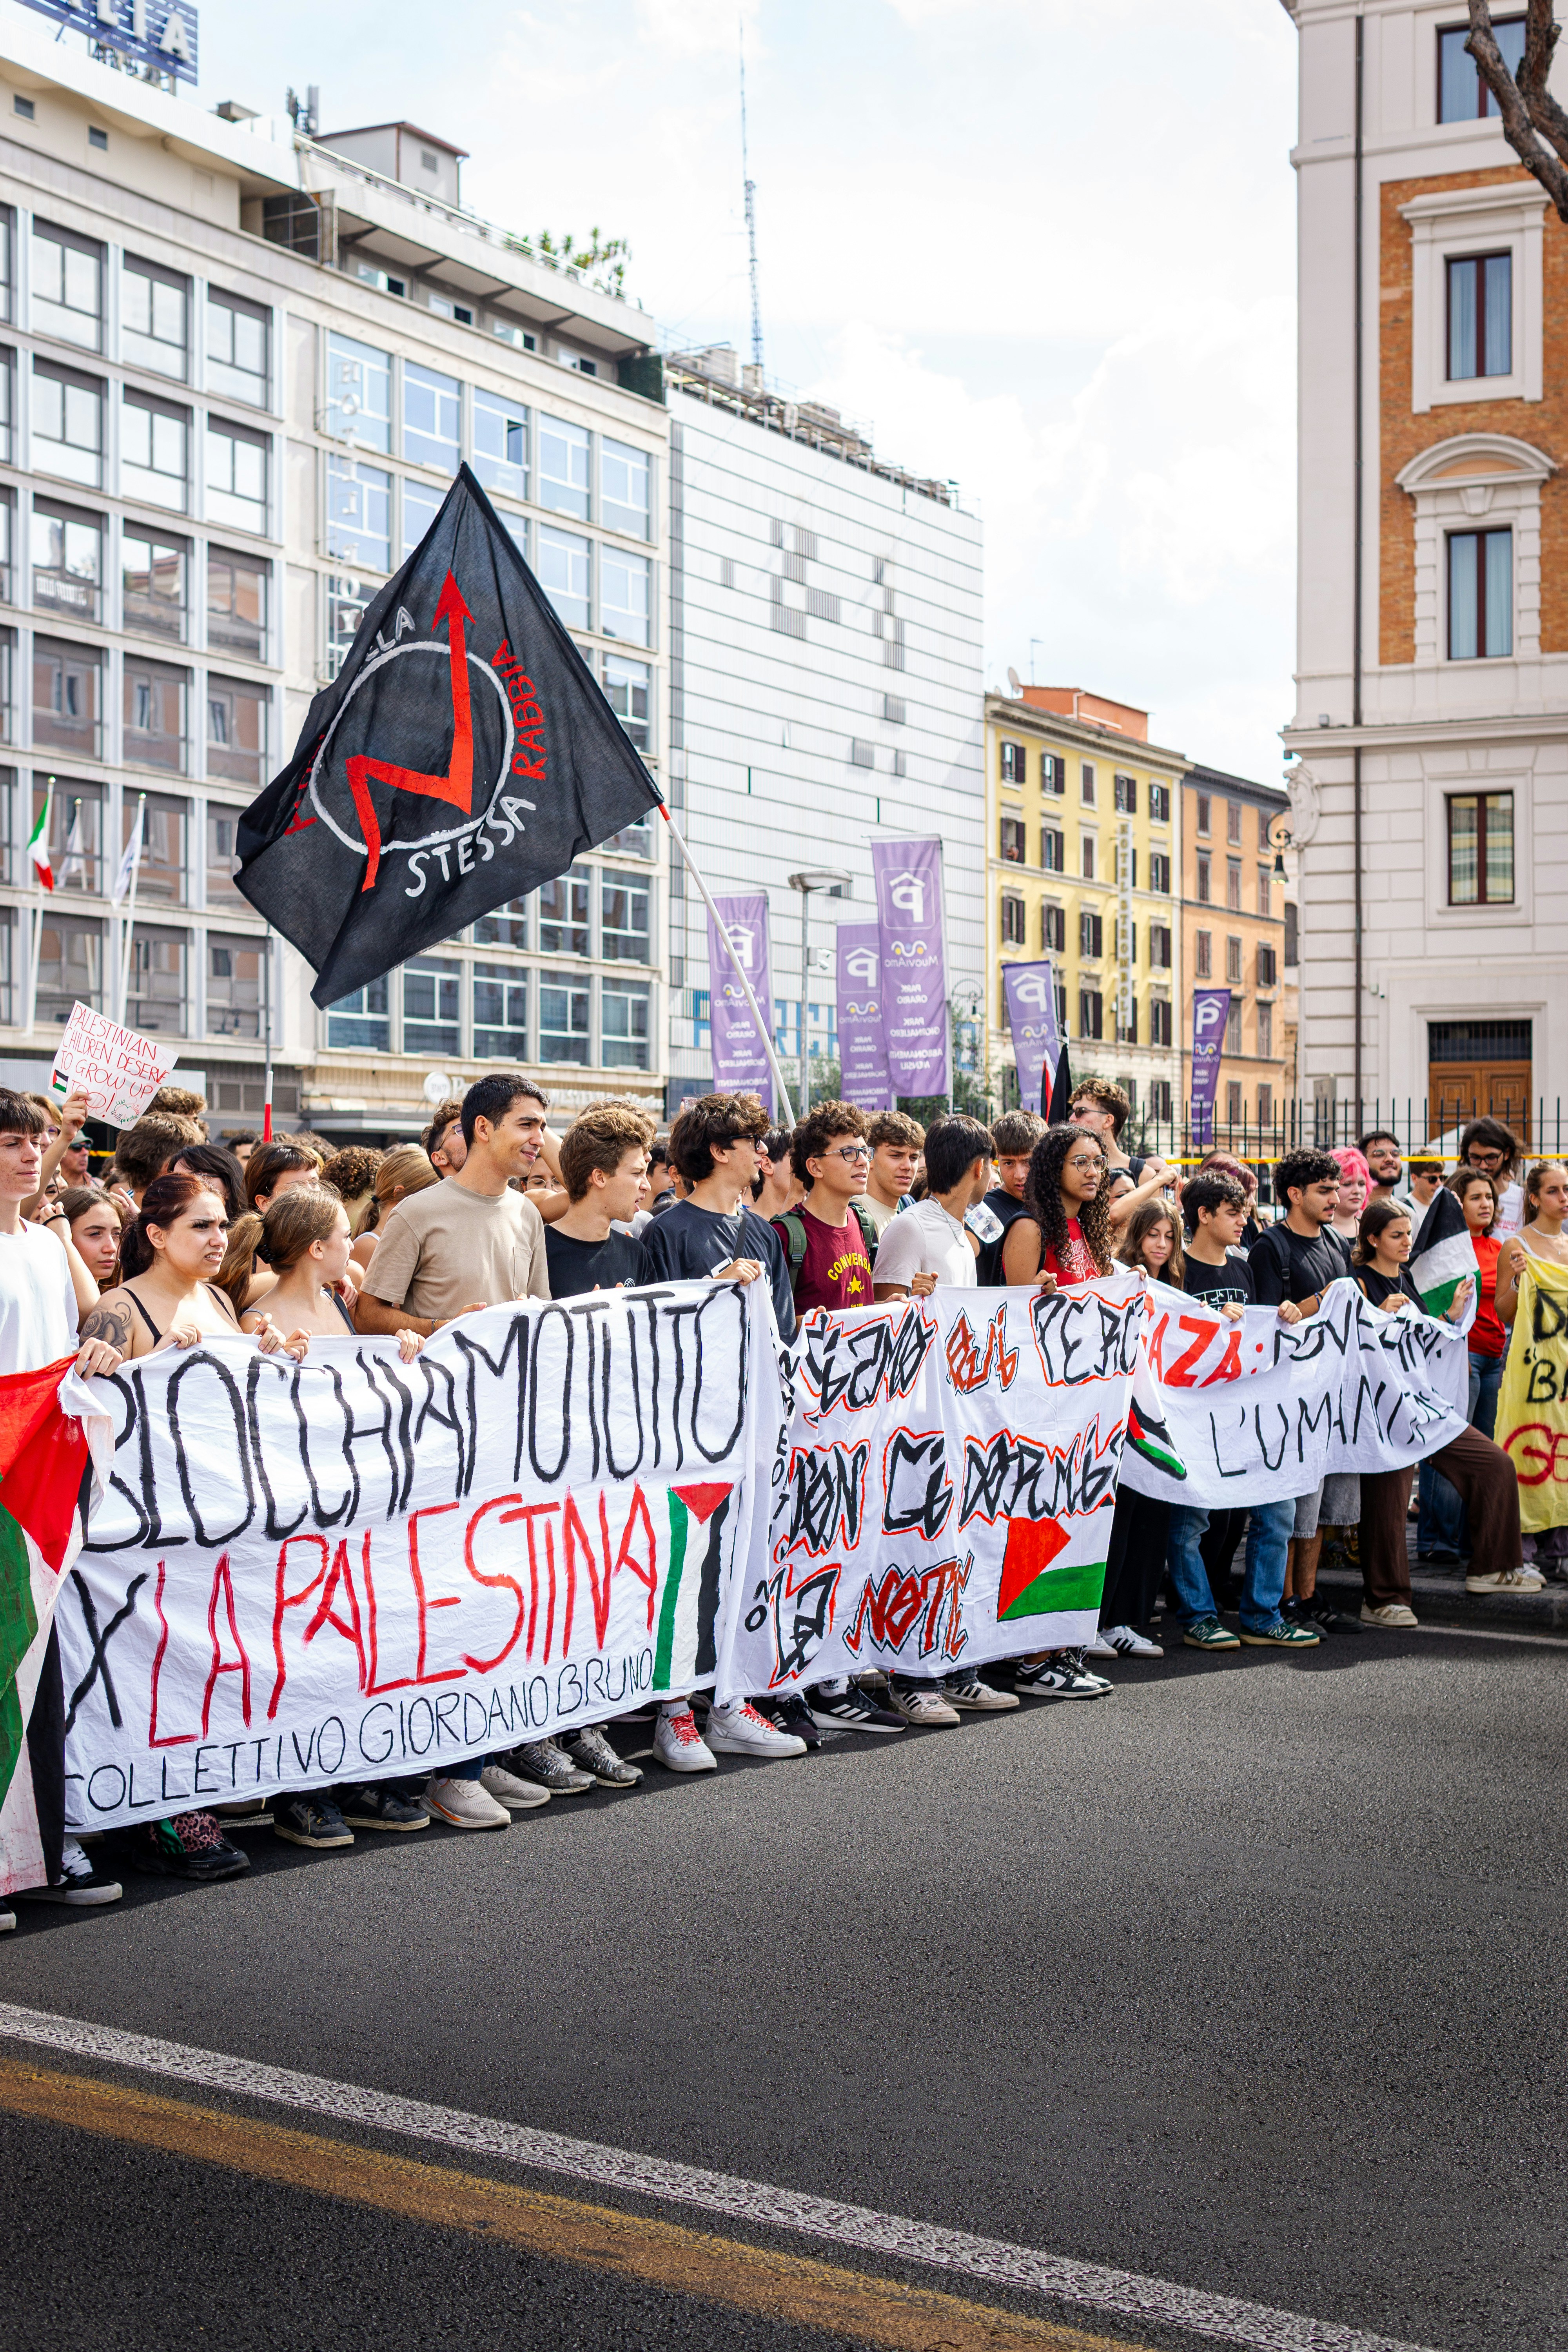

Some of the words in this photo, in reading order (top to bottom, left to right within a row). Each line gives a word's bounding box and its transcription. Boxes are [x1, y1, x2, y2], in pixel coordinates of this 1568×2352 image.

[69, 0, 191, 62] LIA
[492, 639, 548, 781] RABBIA
[405, 796, 536, 898] STESSA
[1120, 824, 1129, 893] HOTEL
[1119, 900, 1130, 1026] STROMBOLI
[61, 1050, 73, 1070] TO
[75, 1059, 125, 1090] GROW
[129, 1082, 153, 1099] UP
[62, 1027, 114, 1064] CHILDREN
[117, 1052, 170, 1085] DESERVE
[69, 1005, 157, 1060] PALESTINIAN
[65, 1569, 150, 1736] X
[149, 1548, 252, 1749] LA
[267, 1477, 658, 1724] PALESTINA
[359, 1675, 548, 1764] GIORDANO
[556, 1648, 653, 1717] BRUNO
